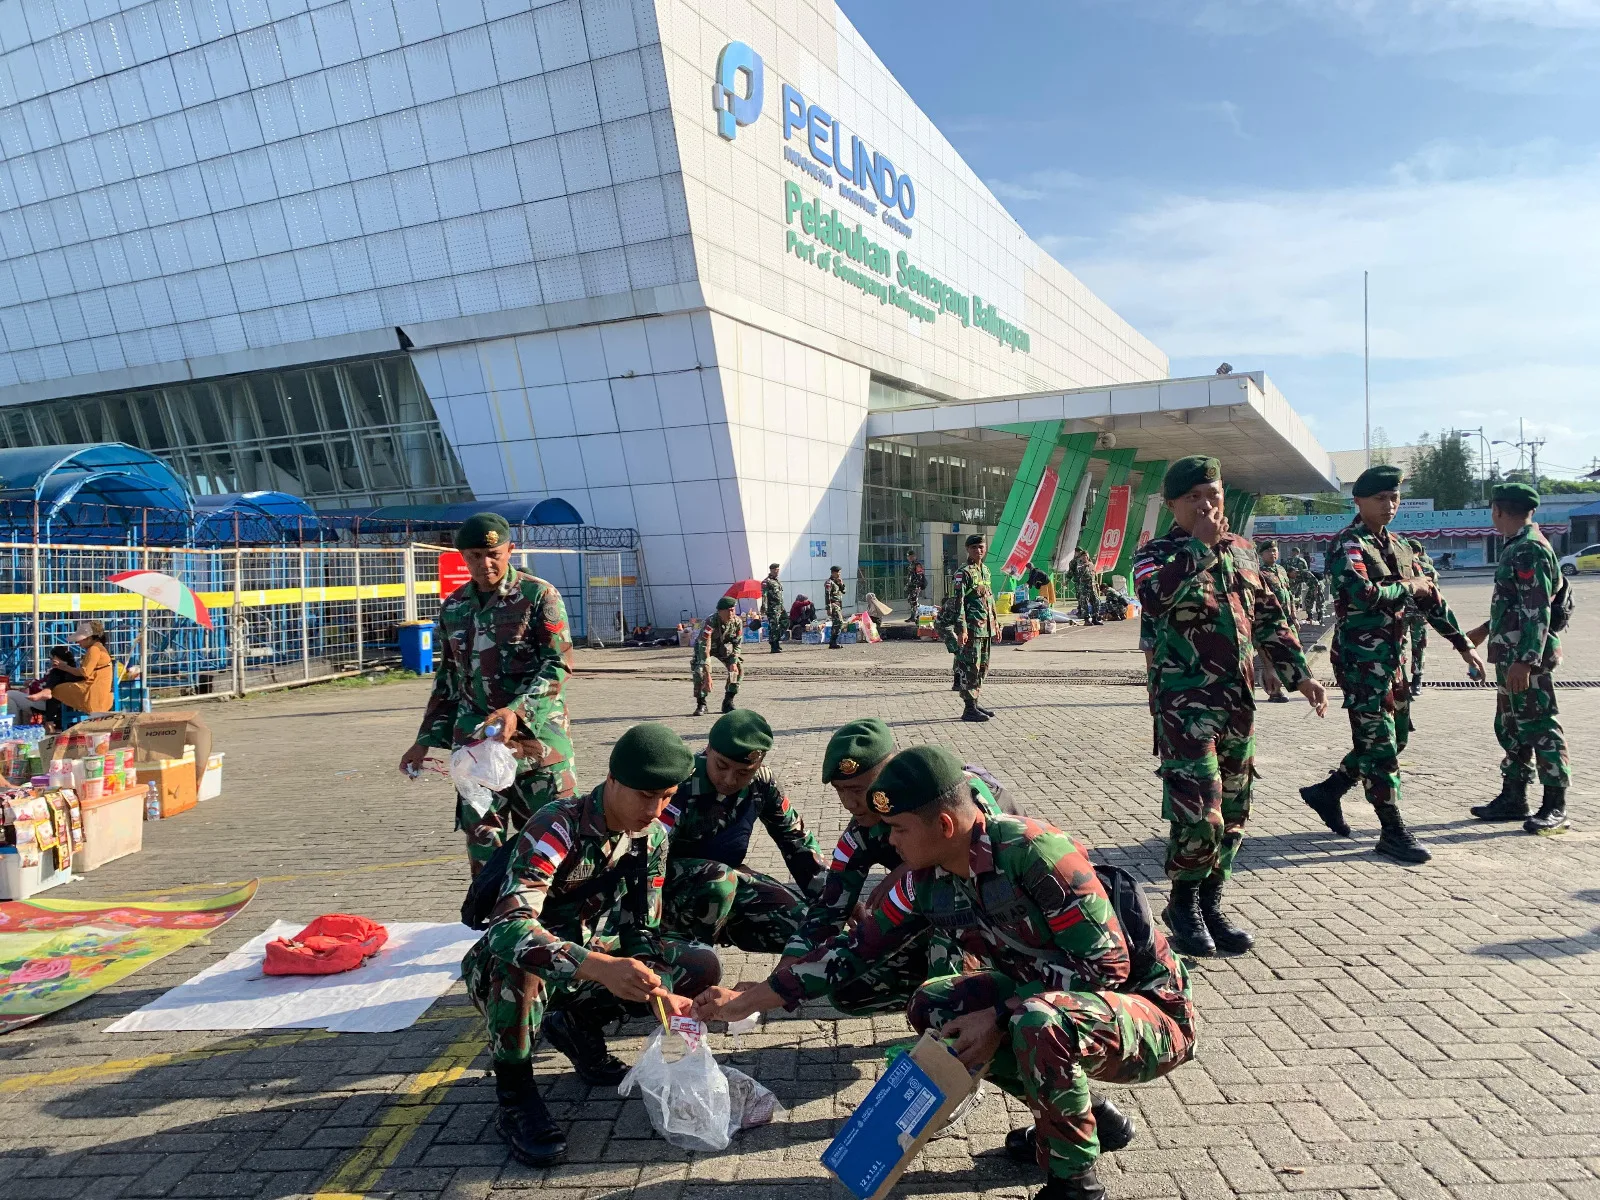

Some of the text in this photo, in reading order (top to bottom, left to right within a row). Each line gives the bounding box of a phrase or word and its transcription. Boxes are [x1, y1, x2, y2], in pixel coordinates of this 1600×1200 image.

[782, 83, 915, 220] PELINDO
[785, 179, 1031, 354] Pelabuhan Semayang Balikpapan
[786, 230, 936, 324] Port of Semayang Balikpapan
[859, 1179, 867, 1188] 12
